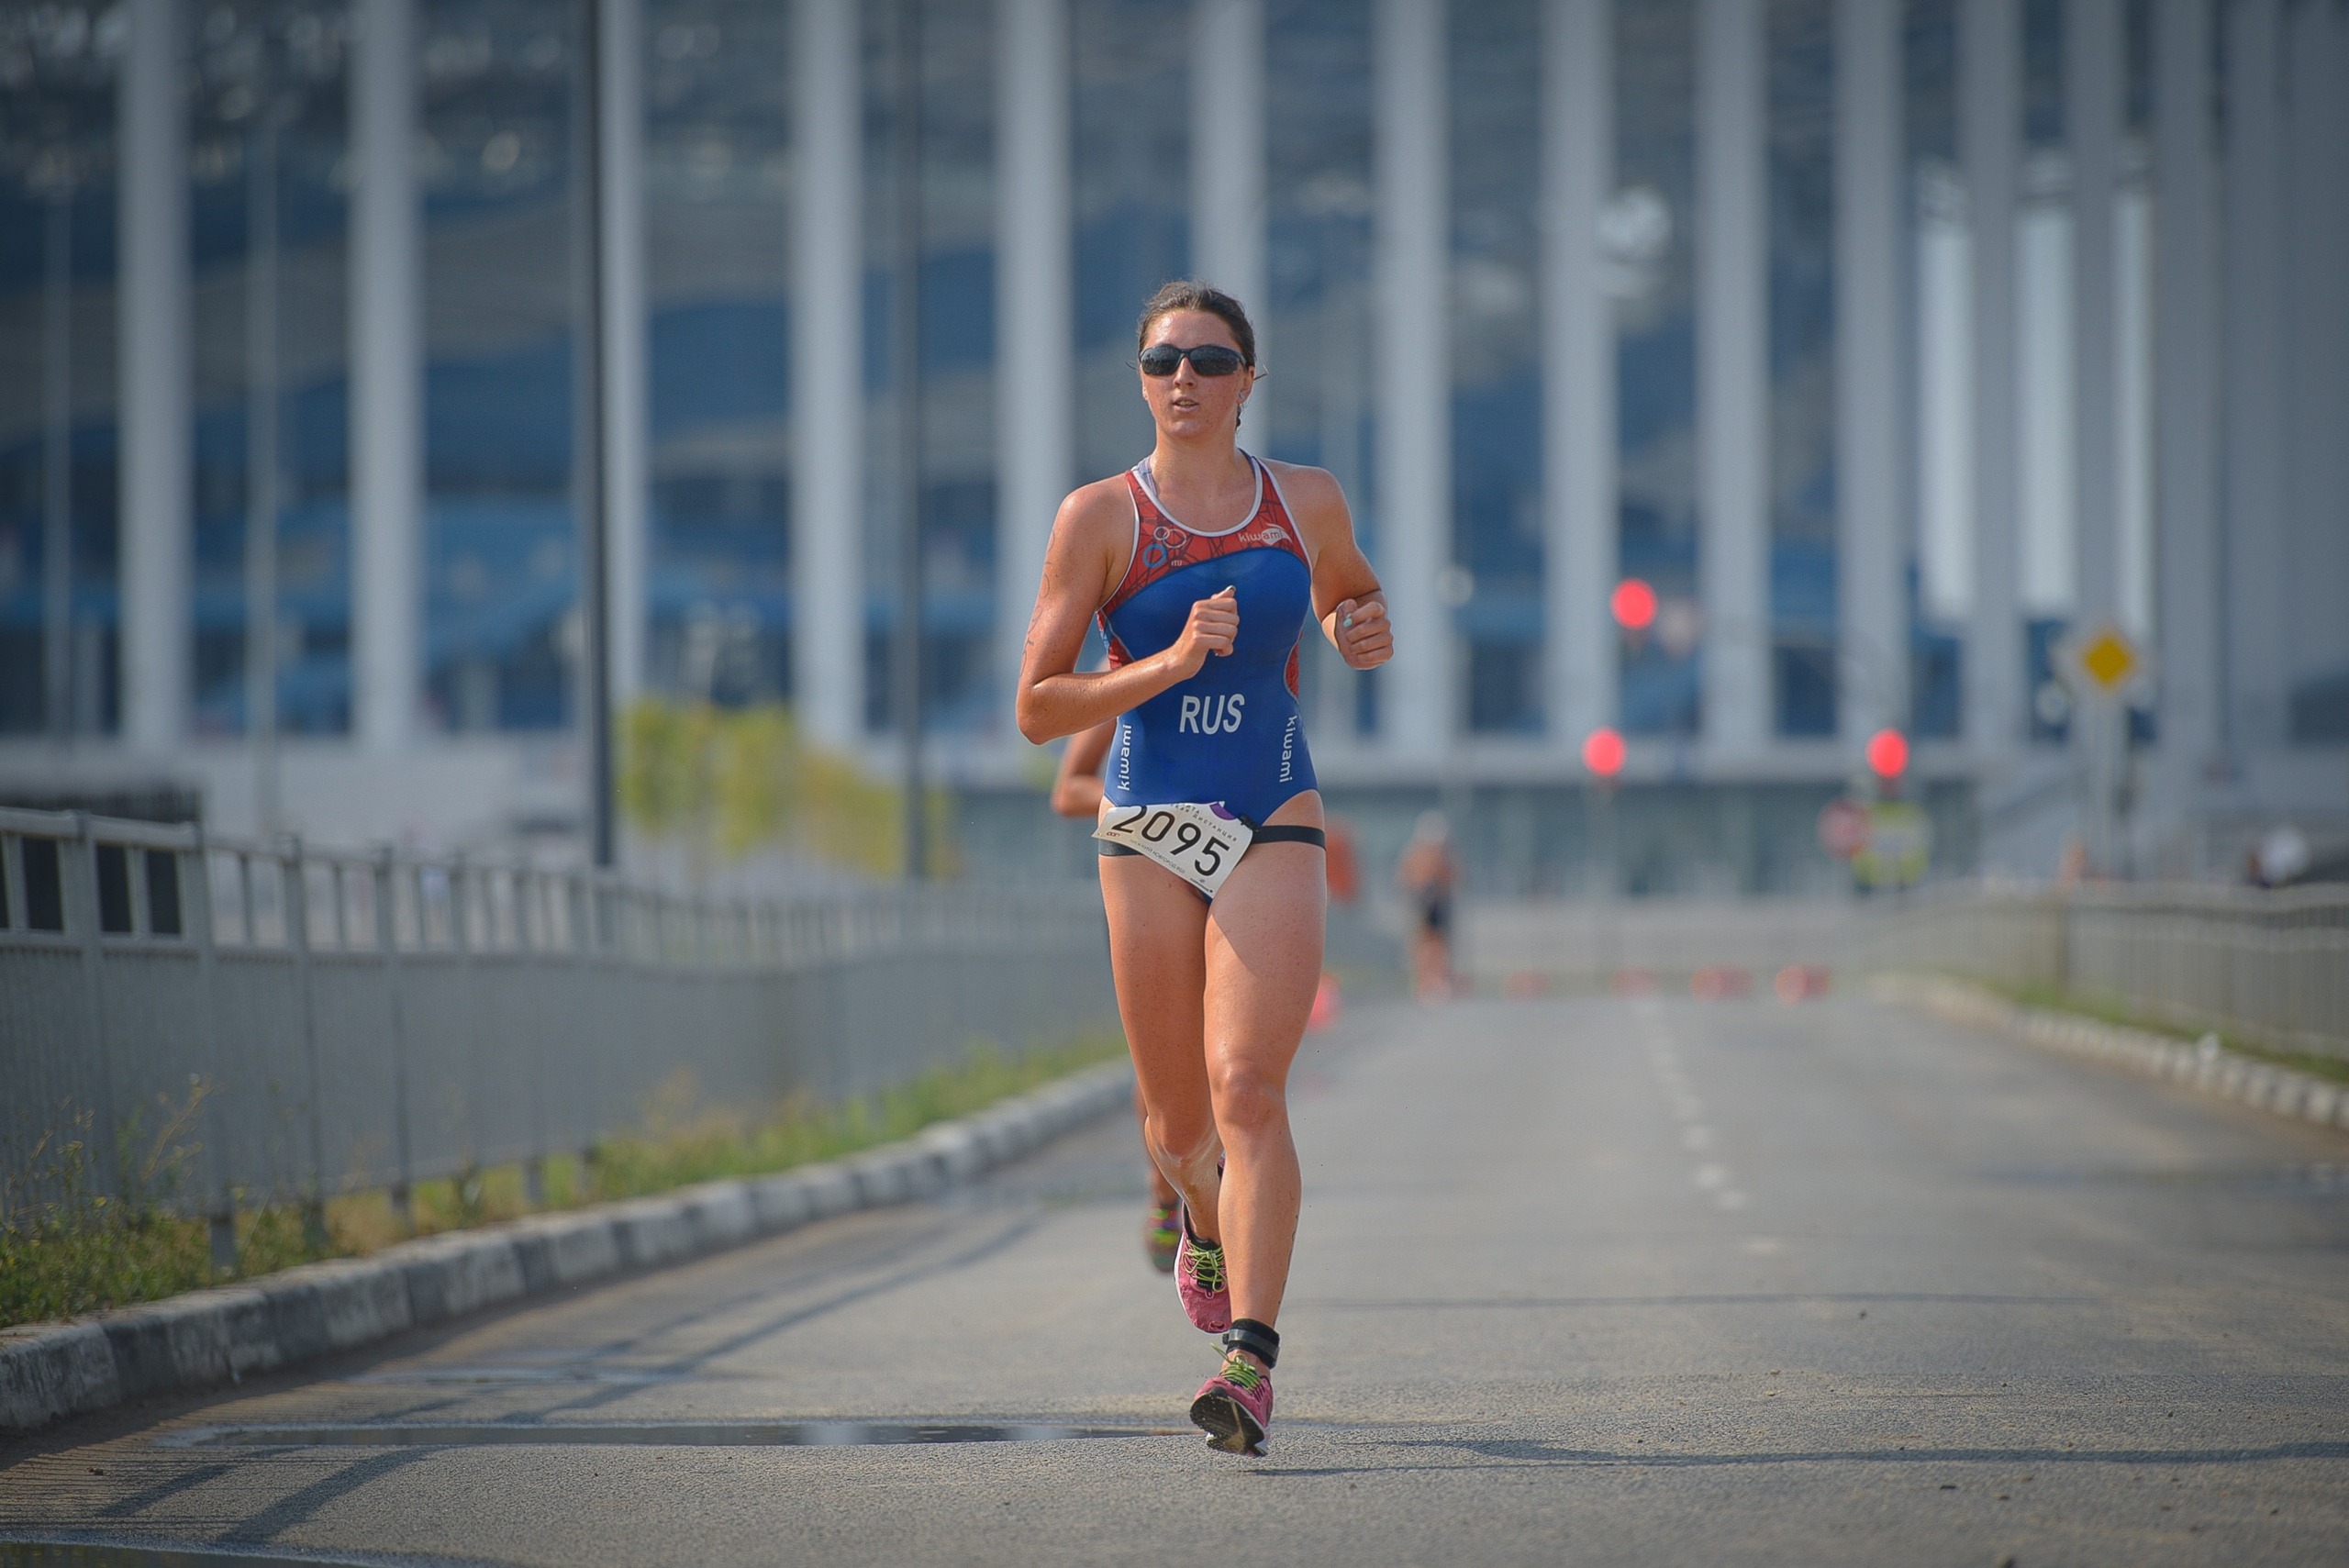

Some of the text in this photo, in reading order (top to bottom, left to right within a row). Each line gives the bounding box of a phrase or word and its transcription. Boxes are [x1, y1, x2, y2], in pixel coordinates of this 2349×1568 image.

[1238, 529, 1284, 543] kiwami
[1179, 693, 1245, 735] RUS
[1117, 724, 1132, 792] kiwami
[1279, 715, 1298, 784] kiwami
[1111, 805, 1230, 877] 2095
[1193, 813, 1238, 842] ДИСТАНЦИЯ
